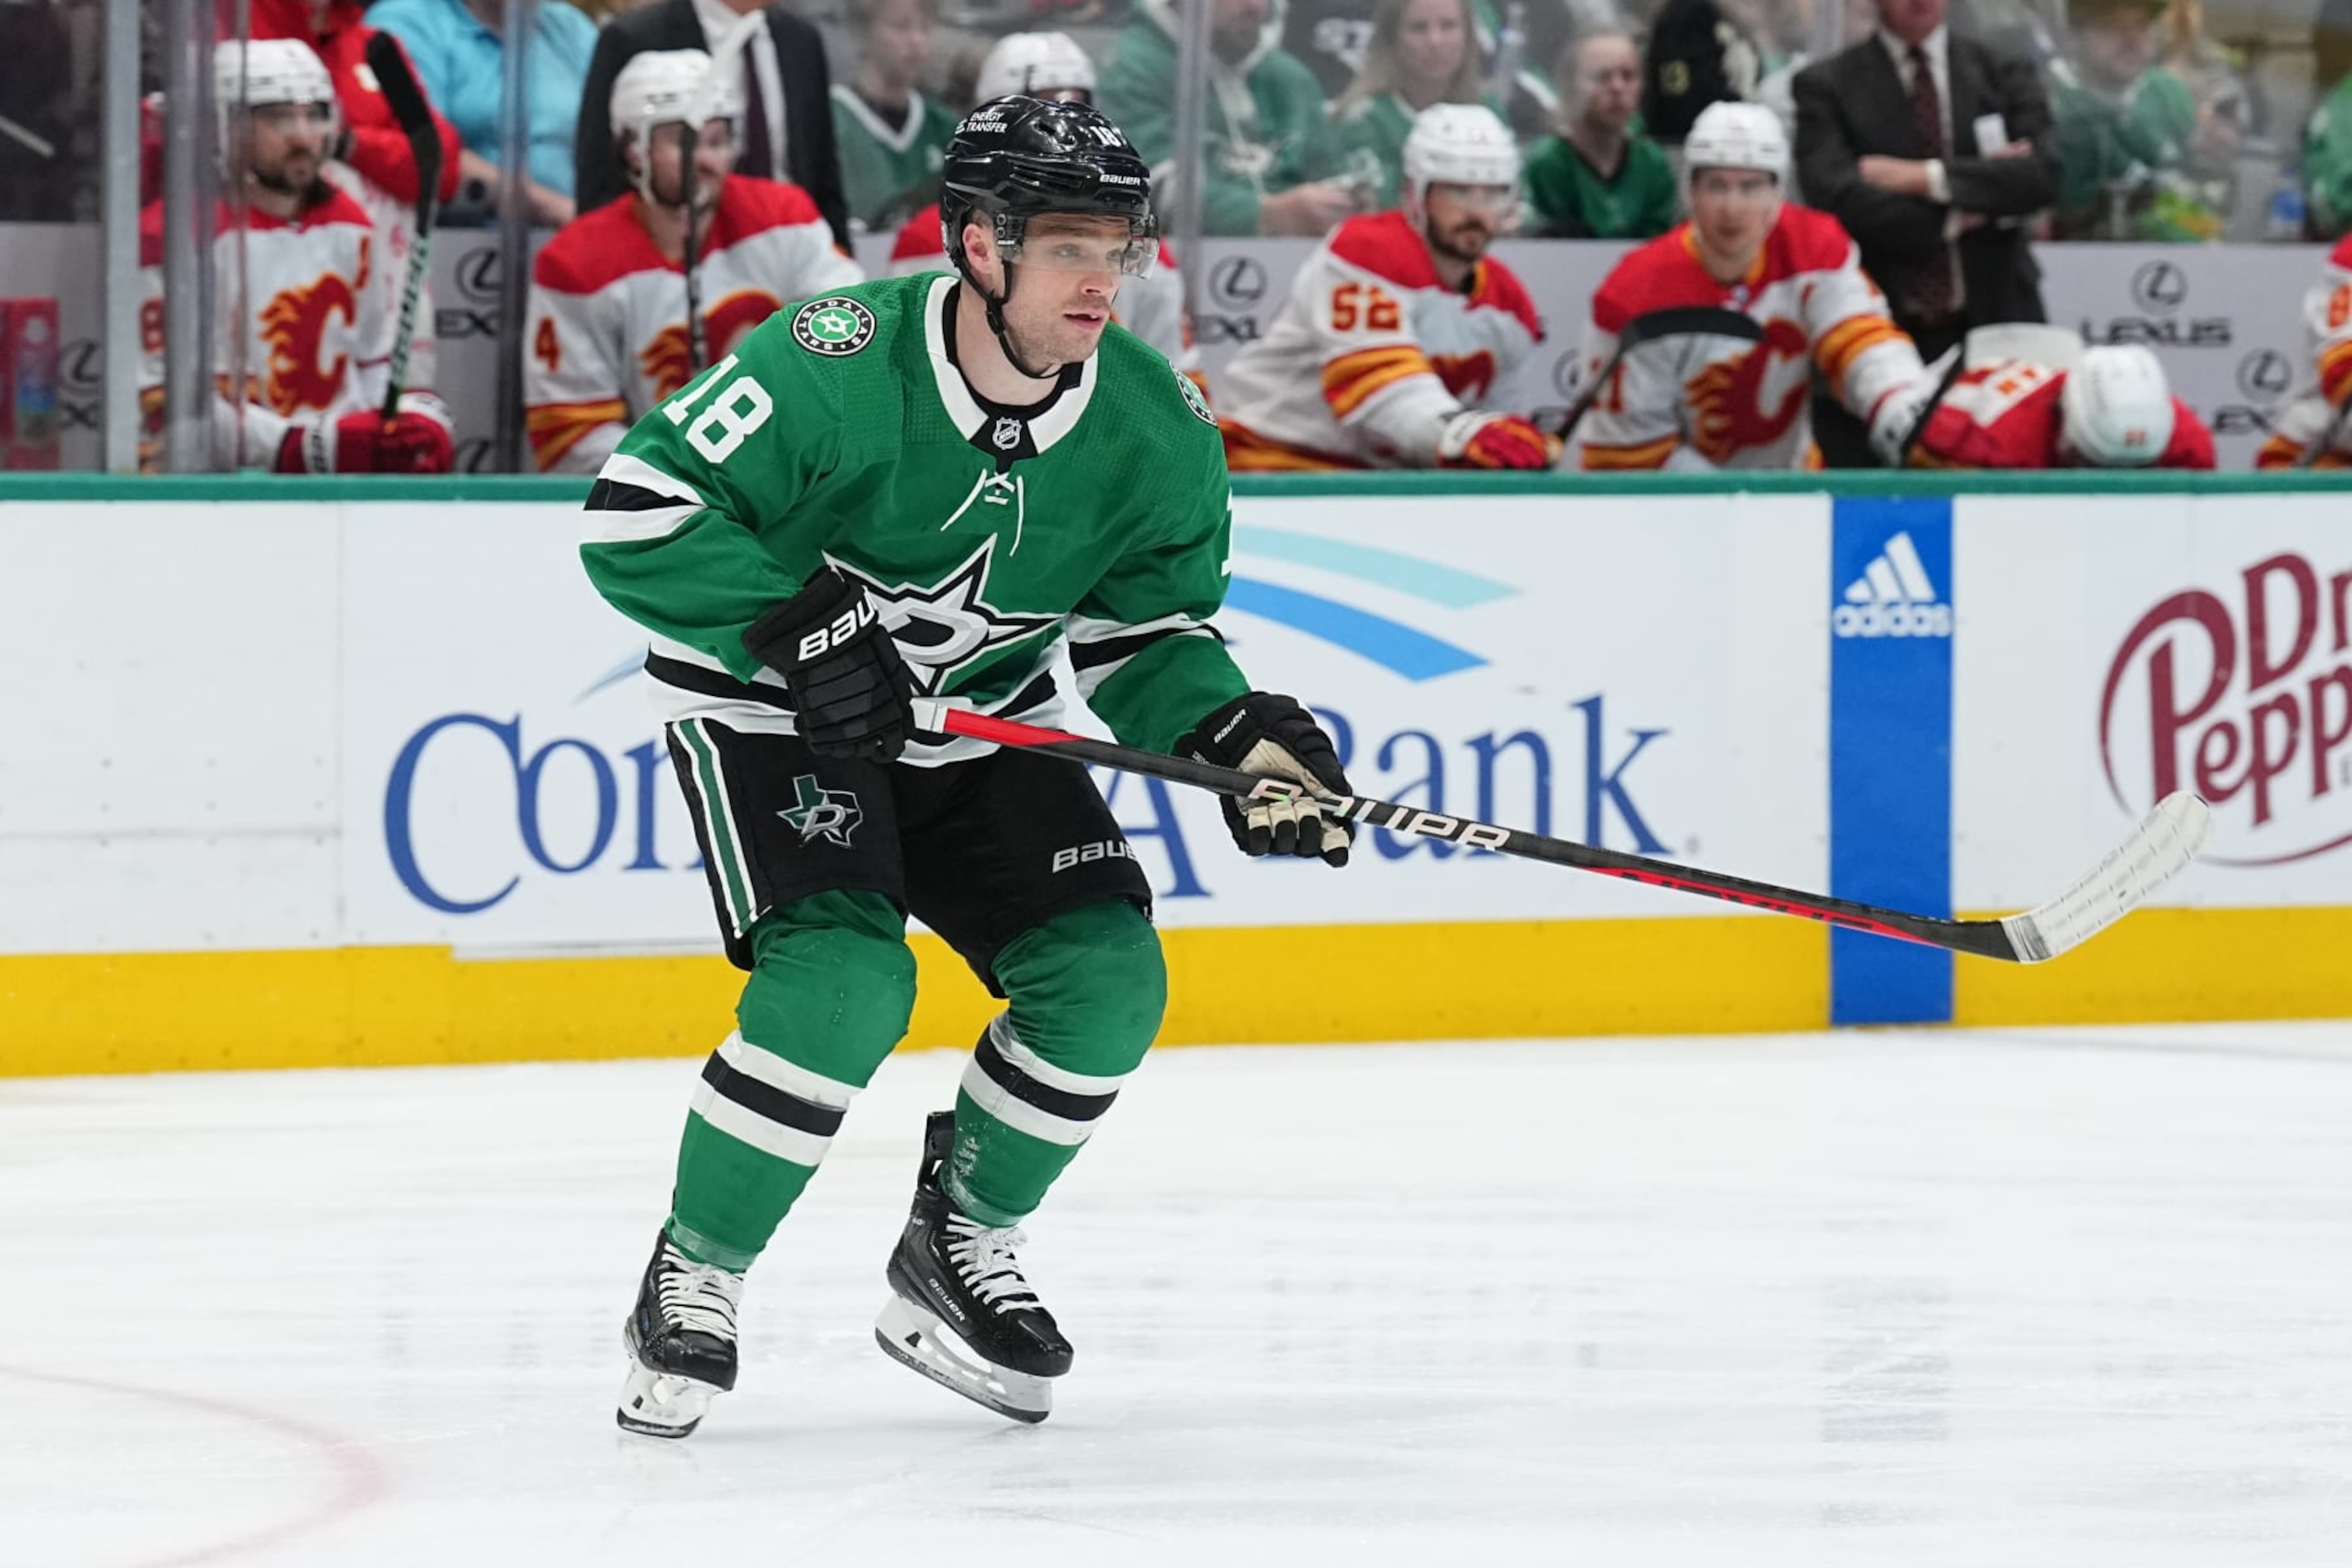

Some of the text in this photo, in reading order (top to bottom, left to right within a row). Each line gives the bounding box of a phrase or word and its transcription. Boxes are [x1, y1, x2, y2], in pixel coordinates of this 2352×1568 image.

[967, 122, 1008, 133] TRANSFER
[970, 111, 1005, 121] ENERGY
[1332, 284, 1400, 331] 52
[2080, 318, 2231, 347] LEXUS
[662, 353, 773, 464] 18
[1833, 603, 1953, 638] adidas
[929, 1278, 965, 1322] BAUER
